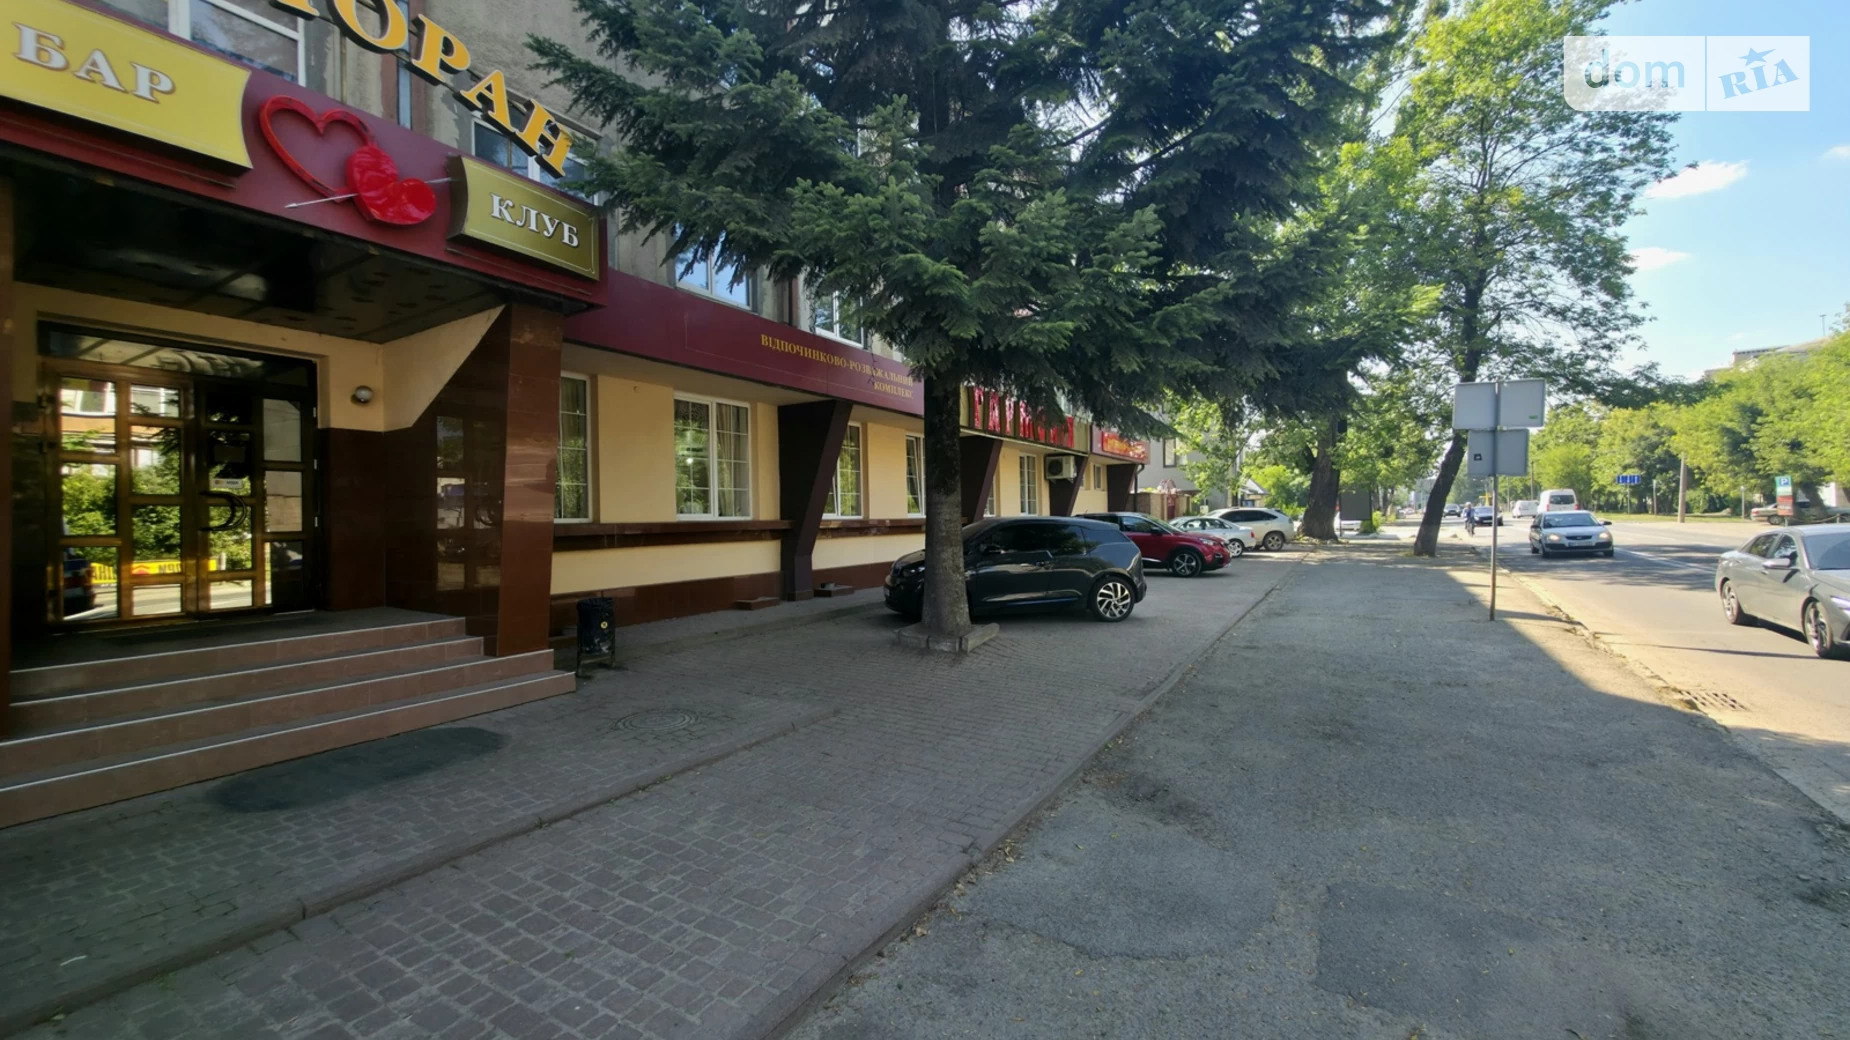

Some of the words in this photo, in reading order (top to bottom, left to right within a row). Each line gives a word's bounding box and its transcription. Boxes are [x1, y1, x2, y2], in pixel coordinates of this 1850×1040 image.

[12, 21, 176, 104] БАР
[271, 0, 573, 178] ОРАН
[490, 192, 580, 248] КЛУБ
[873, 383, 914, 399] КОМПЛЕКС
